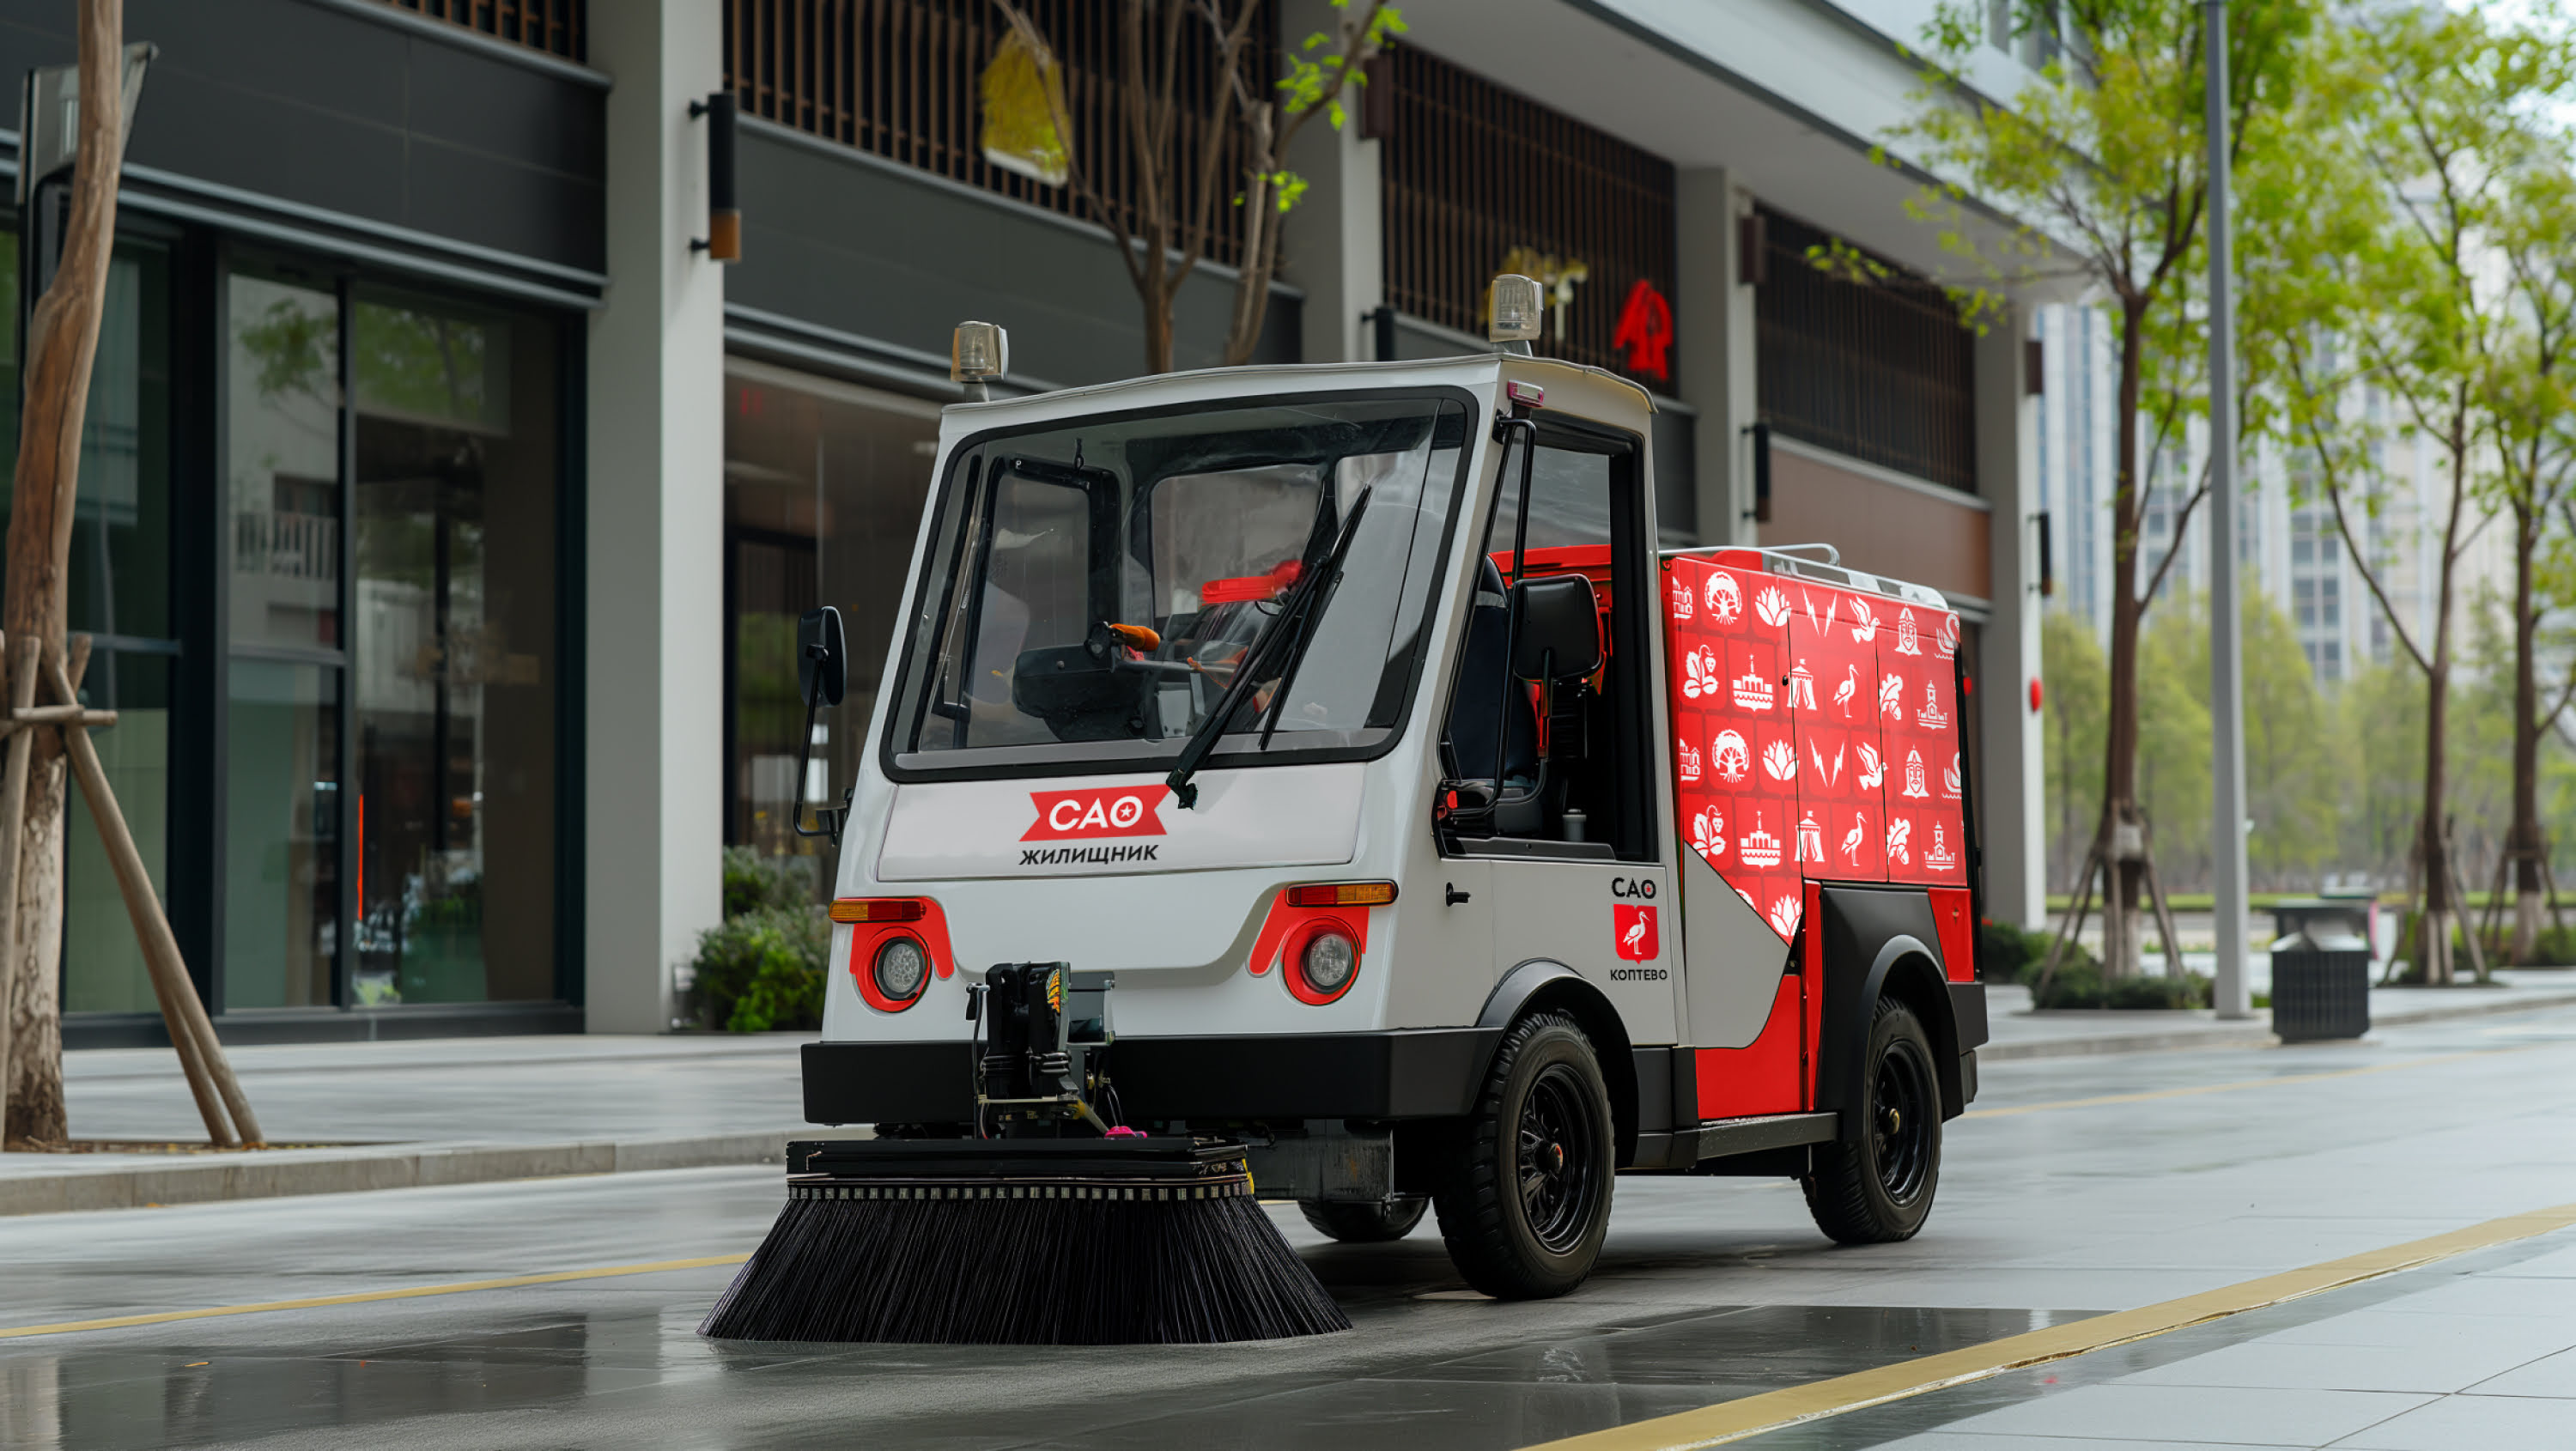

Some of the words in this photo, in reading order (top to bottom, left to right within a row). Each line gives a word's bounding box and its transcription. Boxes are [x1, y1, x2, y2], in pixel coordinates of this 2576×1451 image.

[1048, 795, 1144, 831] САО
[1018, 844, 1159, 865] ЖИЛИЩНИК
[1611, 877, 1657, 900] САО
[1610, 969, 1668, 981] КОПТЕВО
